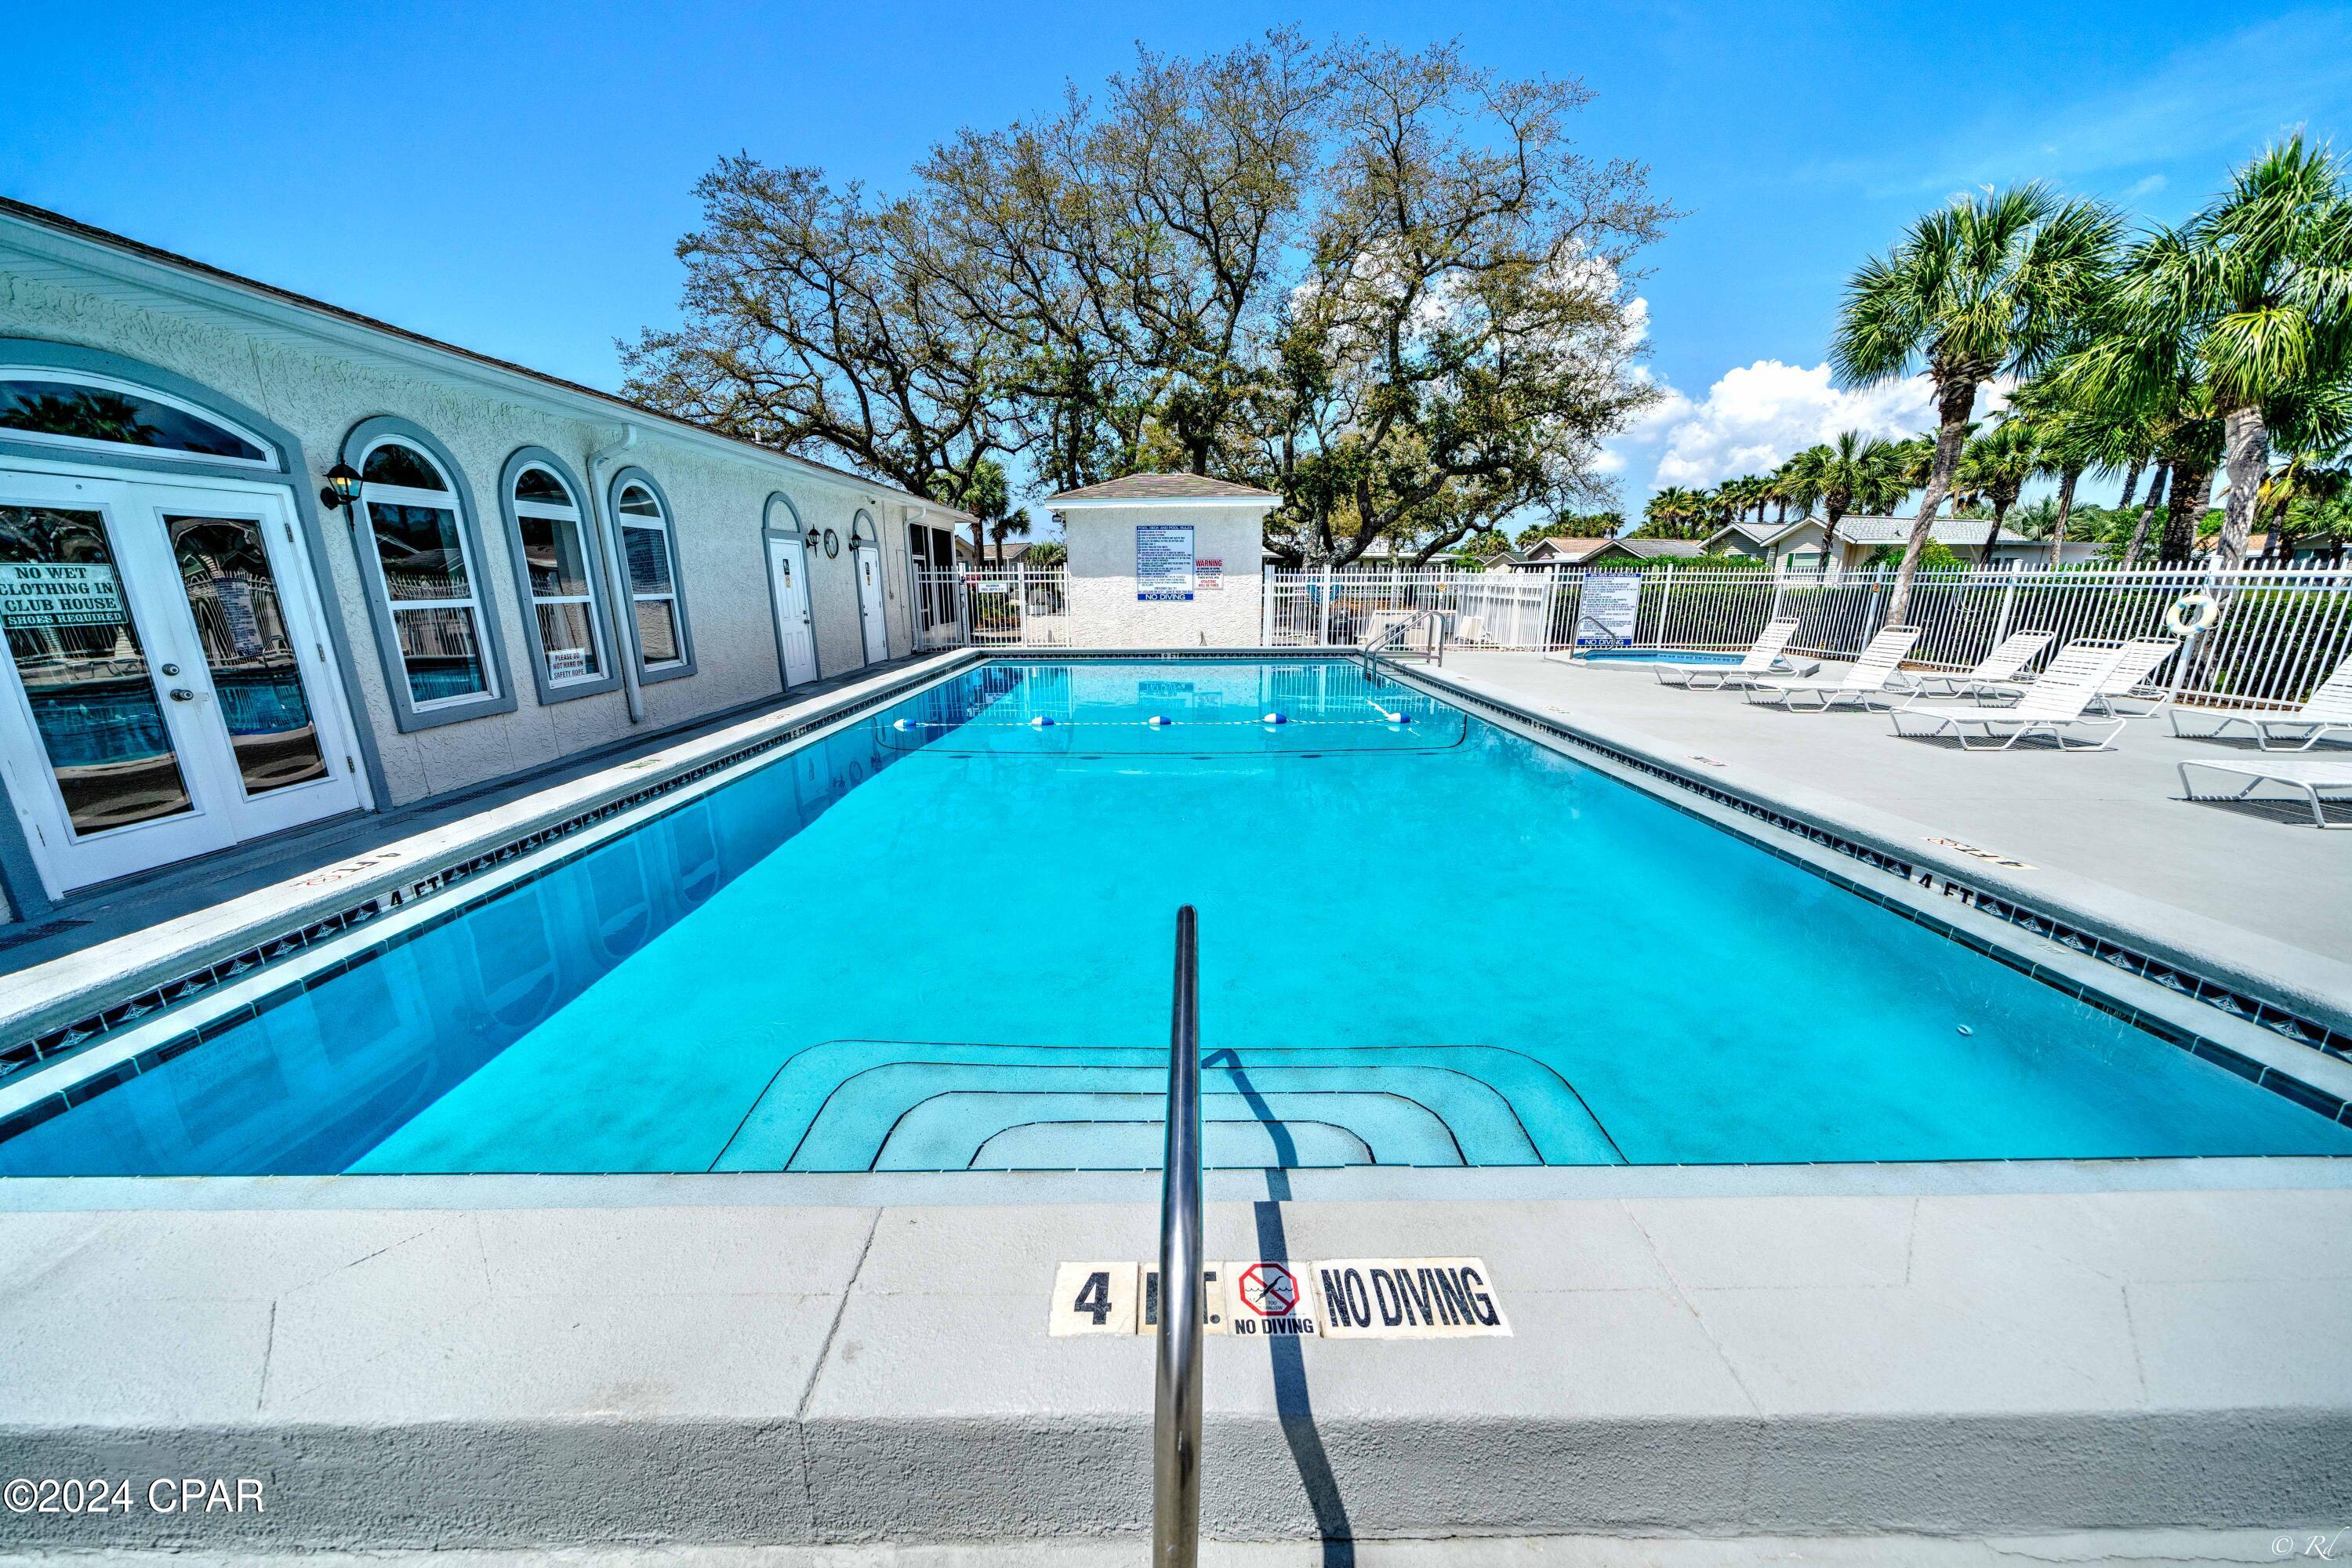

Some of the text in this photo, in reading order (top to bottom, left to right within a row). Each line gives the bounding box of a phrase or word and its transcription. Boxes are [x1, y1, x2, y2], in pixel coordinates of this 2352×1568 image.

[14, 567, 87, 579] NO WET
[0, 583, 114, 596] CLOTHING IN
[5, 597, 117, 612] CLUB HOUSE
[7, 612, 122, 625] SHOES REQUIRED
[554, 668, 584, 679] SAFETY ROPE
[1918, 873, 1933, 889] 4
[390, 890, 405, 906] 4
[1073, 1272, 1112, 1325] 4
[1320, 1266, 1501, 1328] NO DIVING
[1235, 1318, 1314, 1334] NO DIVING
